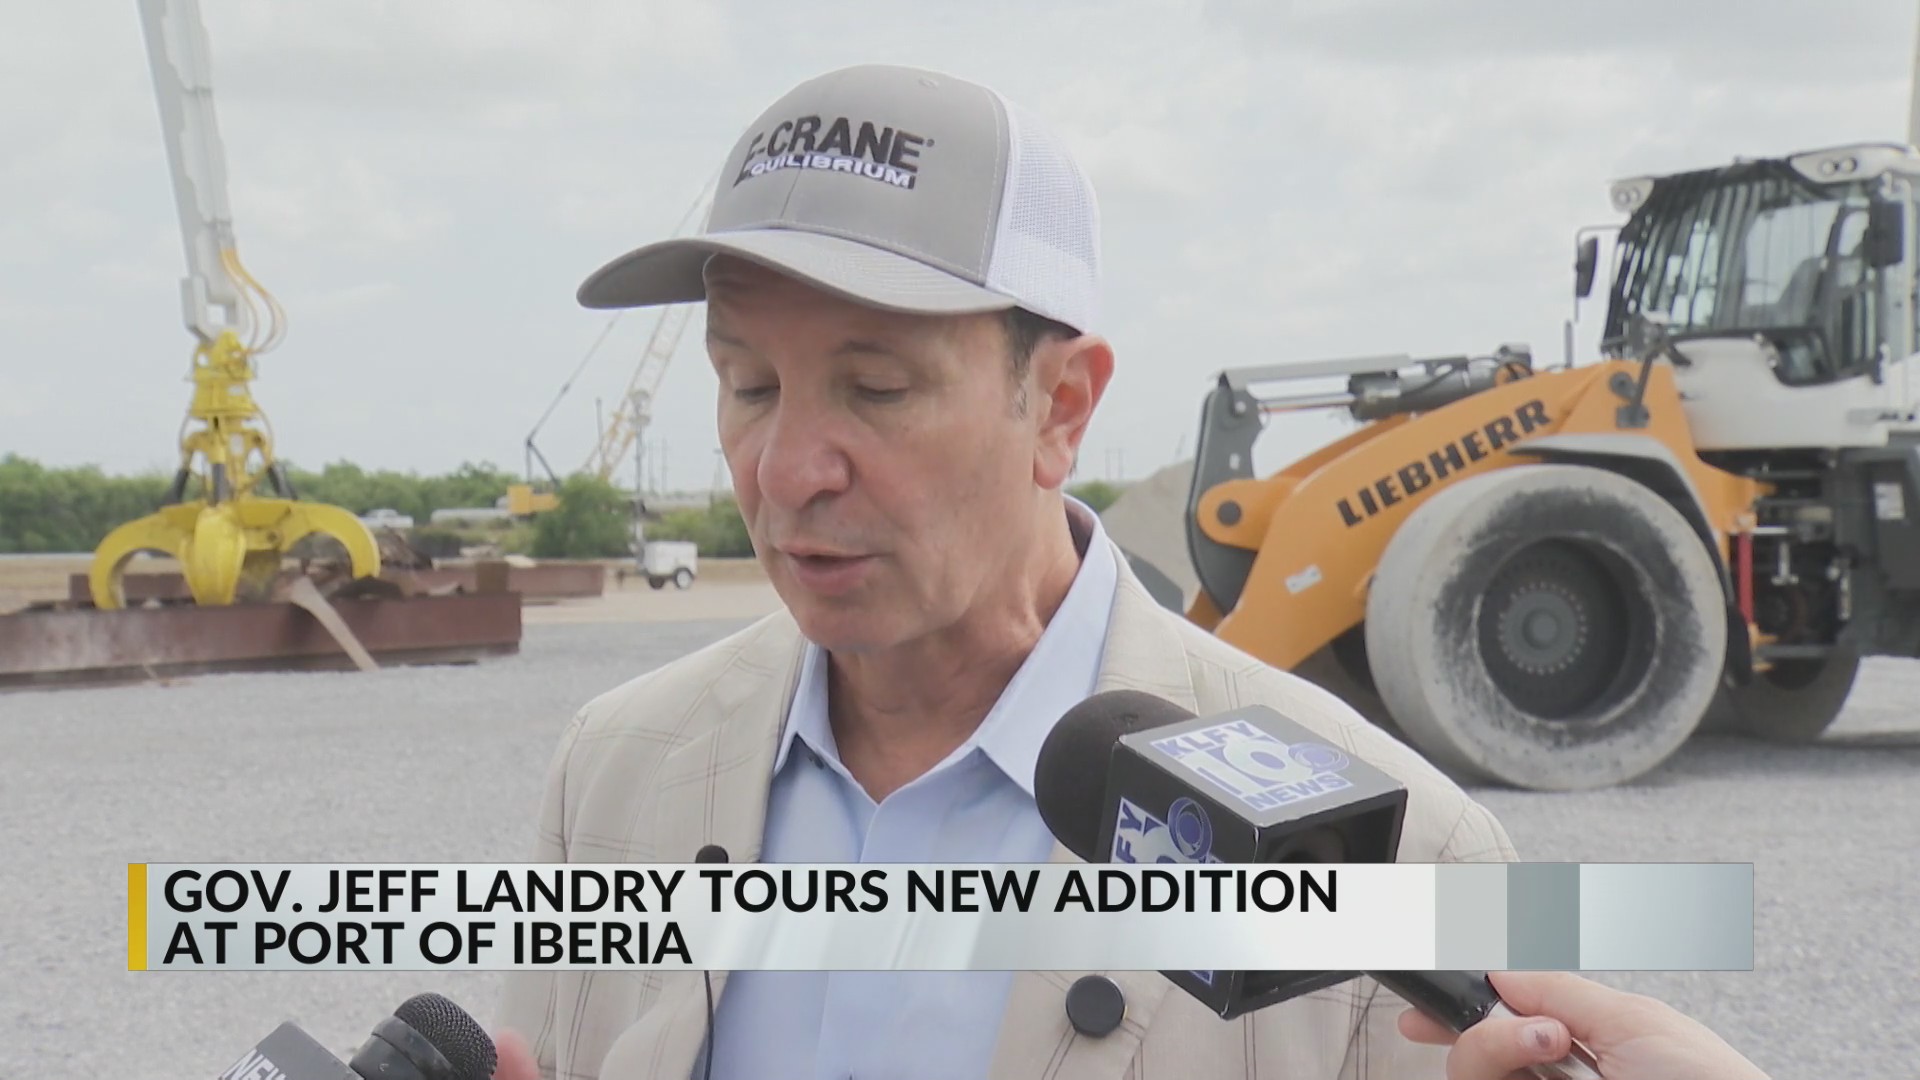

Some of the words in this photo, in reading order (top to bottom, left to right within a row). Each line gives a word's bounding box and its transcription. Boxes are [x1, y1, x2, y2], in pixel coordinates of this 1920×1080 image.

[1335, 399, 1553, 528] LIEBHERR
[1155, 721, 1256, 758] KLFY
[1245, 773, 1350, 809] NEWS
